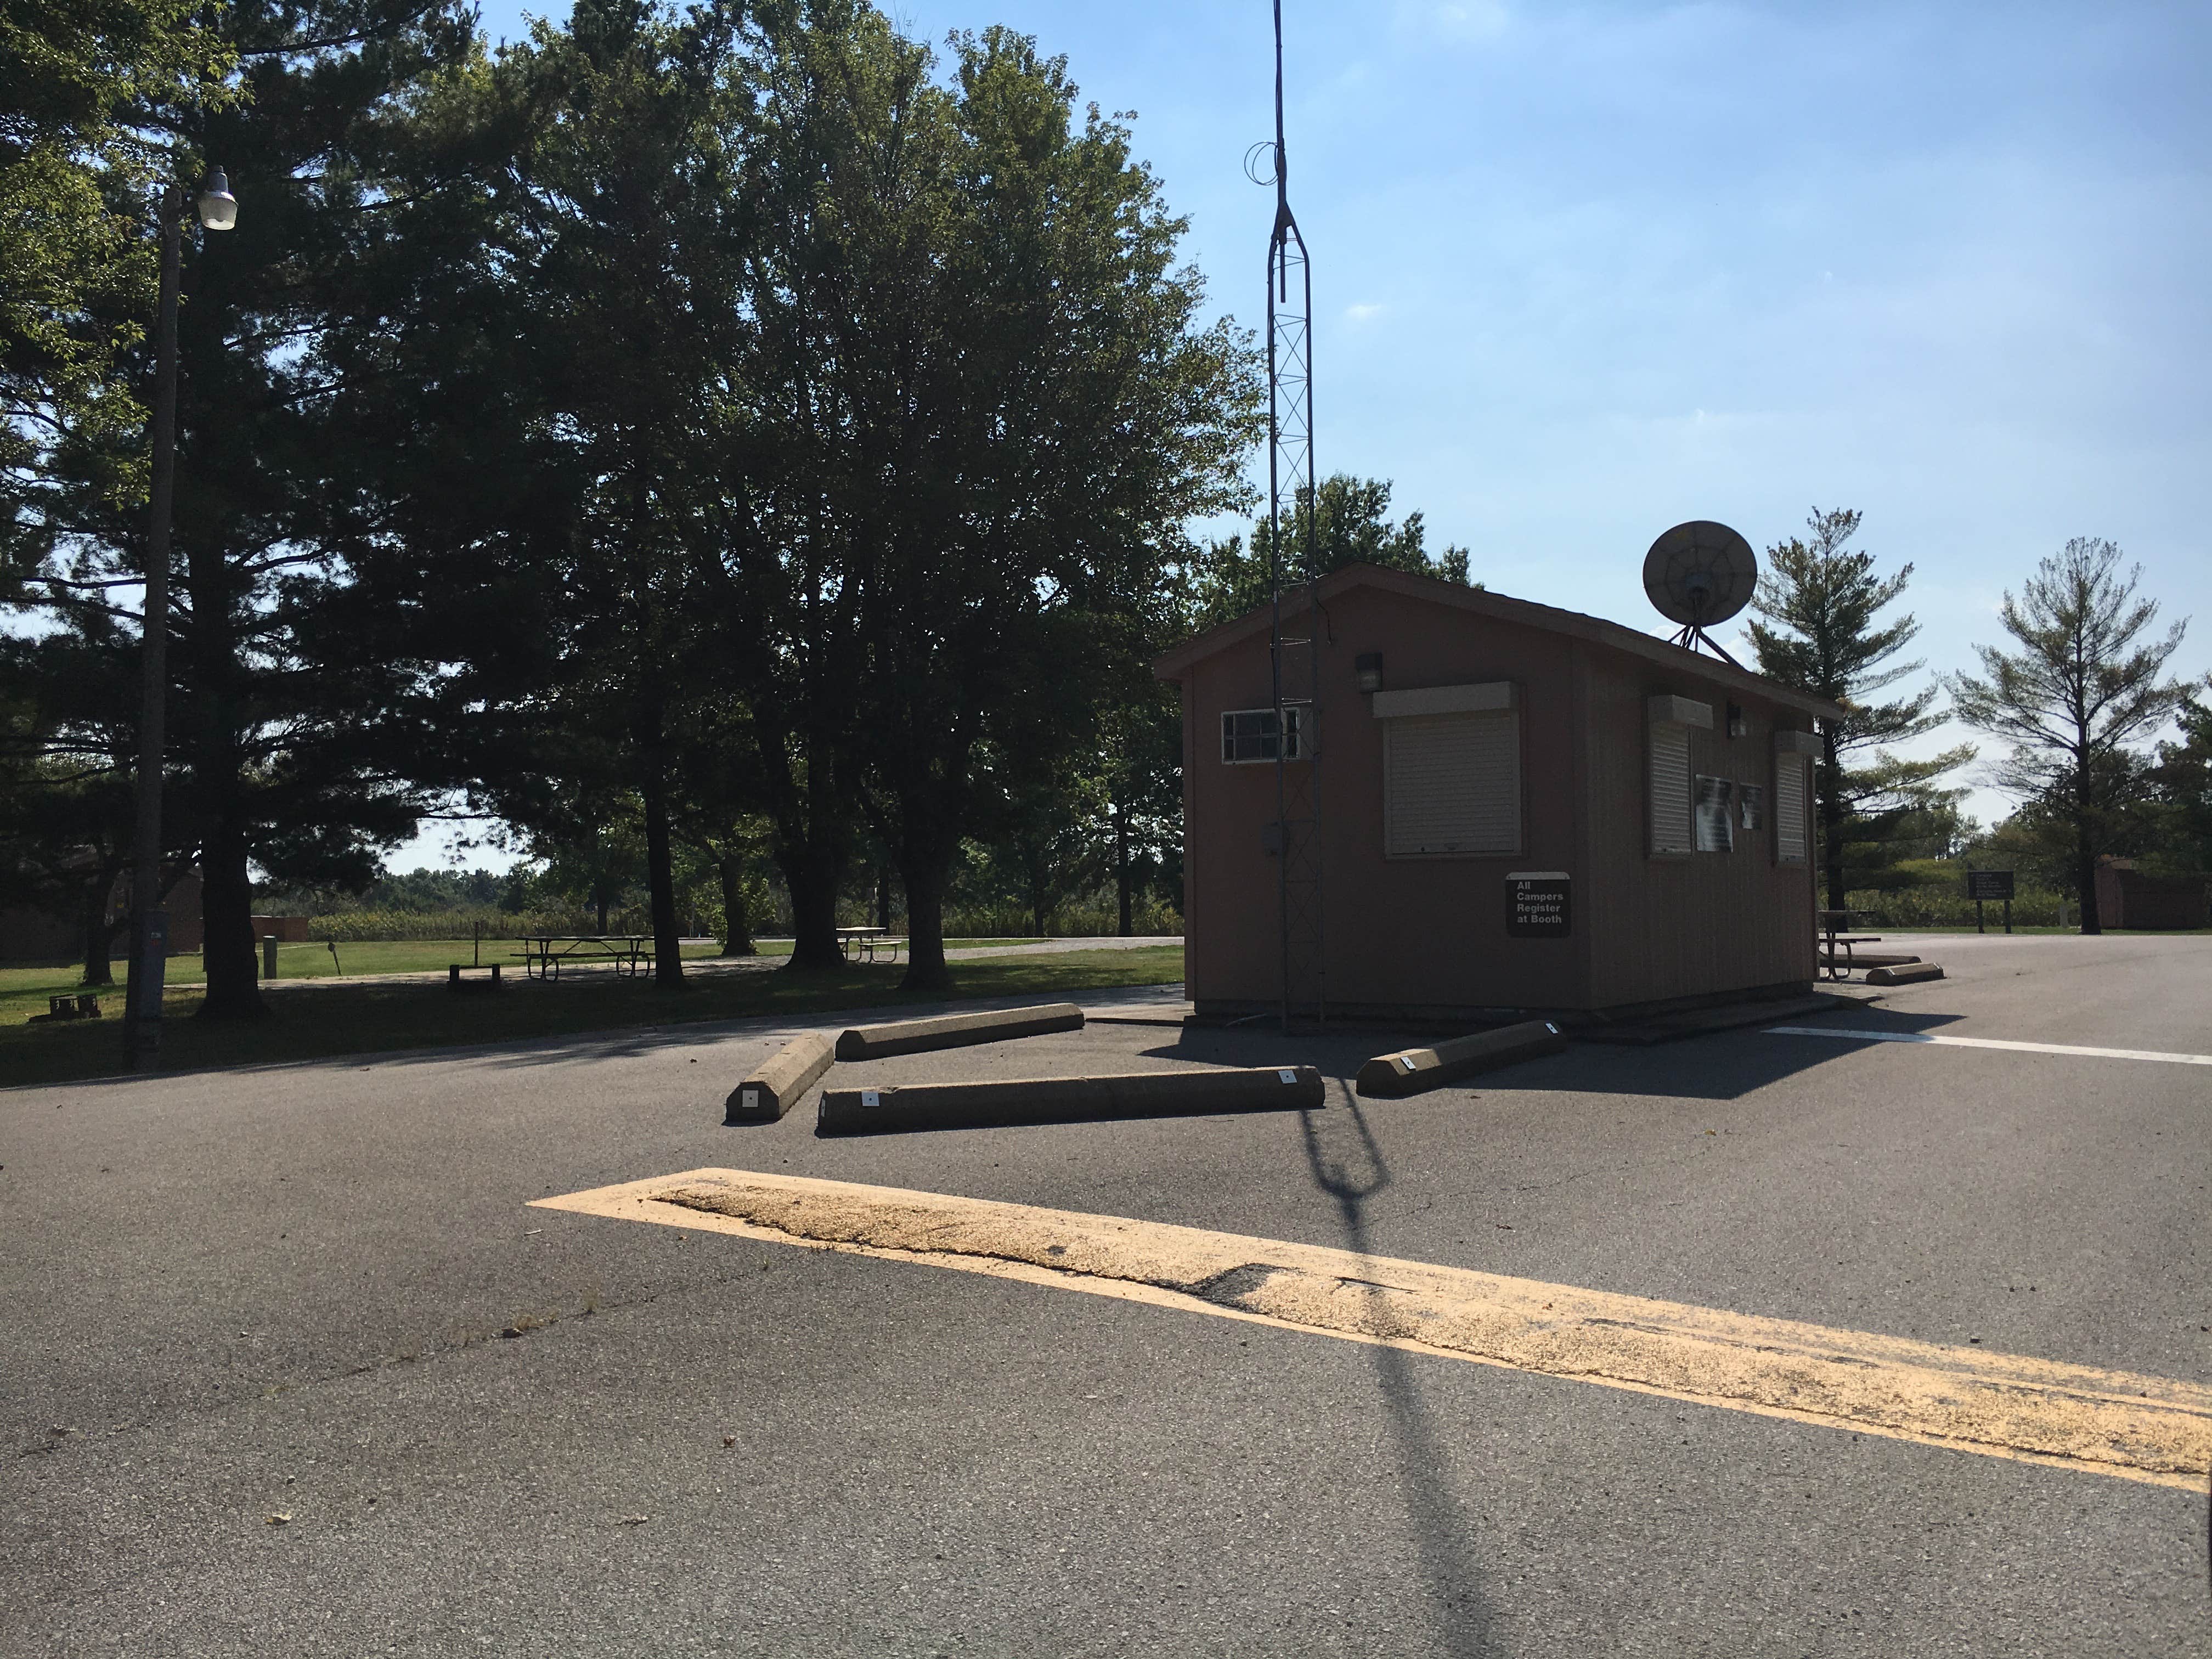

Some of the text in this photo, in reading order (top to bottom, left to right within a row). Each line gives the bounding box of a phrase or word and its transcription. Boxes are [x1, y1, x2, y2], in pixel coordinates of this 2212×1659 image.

[1517, 881, 1531, 889] All
[1516, 892, 1564, 902] Campers
[1517, 904, 1561, 913] Register
[1531, 915, 1562, 923] Booth
